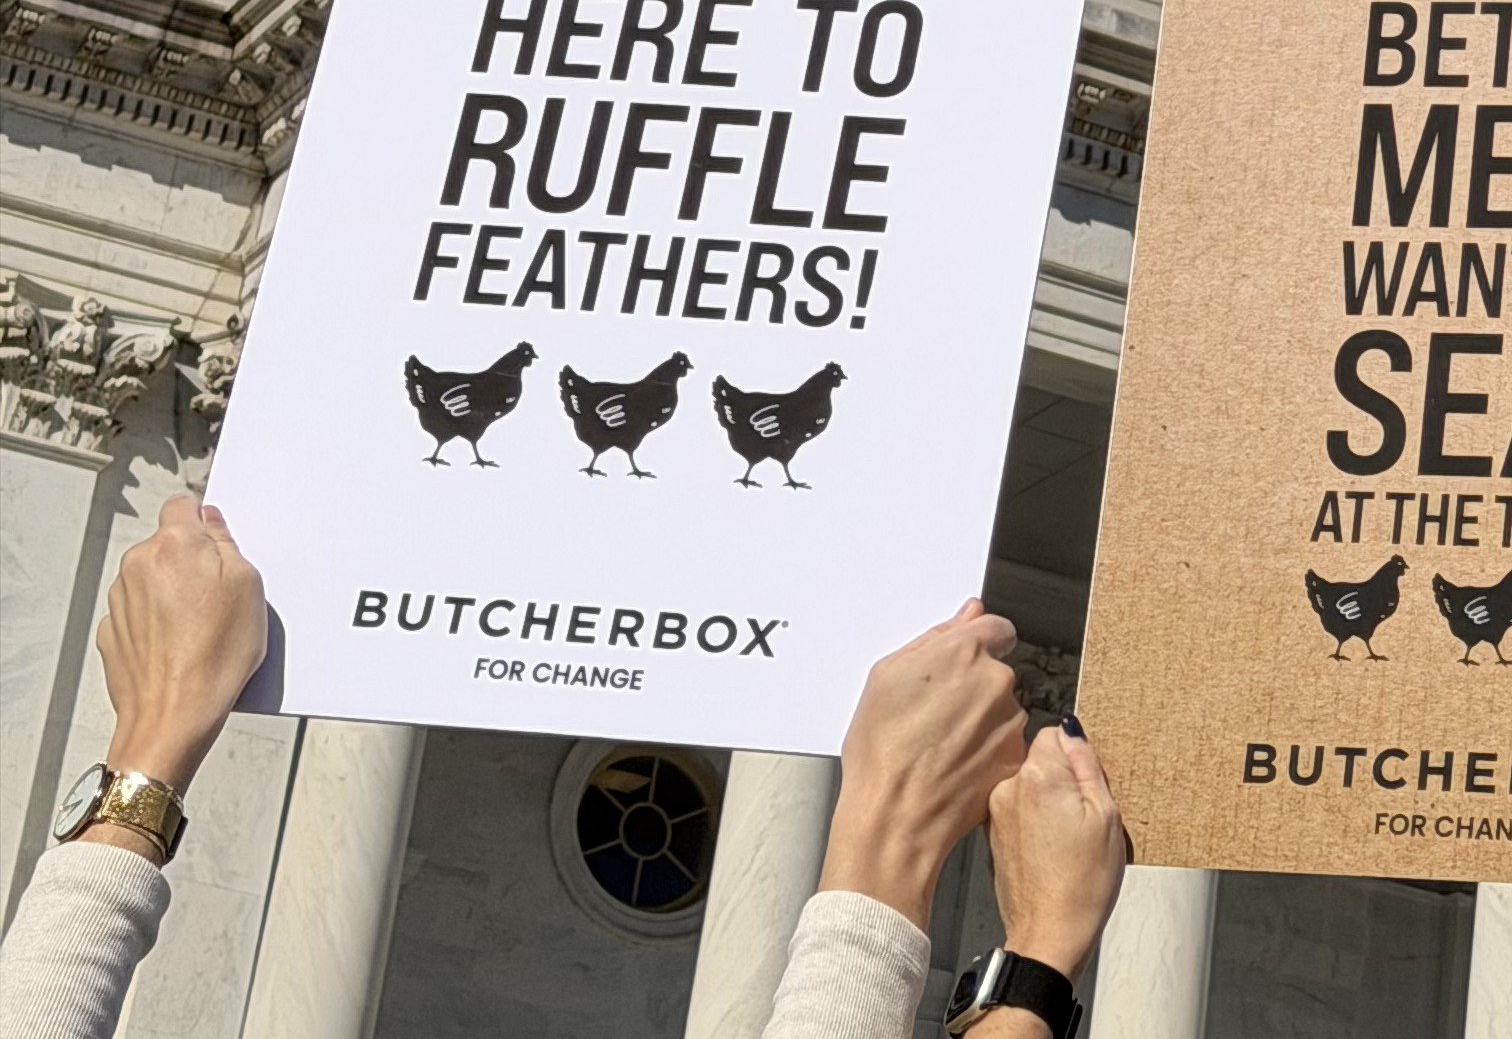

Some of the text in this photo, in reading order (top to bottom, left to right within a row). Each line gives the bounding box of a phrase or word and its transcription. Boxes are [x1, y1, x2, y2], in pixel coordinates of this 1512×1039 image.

[439, 92, 907, 233] RUFFLE
[413, 221, 880, 330] FEATHERS!
[1310, 490, 1376, 544] AT
[1385, 491, 1484, 547] THE
[352, 590, 780, 658] BUTCHERBOX
[473, 657, 645, 691] FOR CHANGE
[1374, 812, 1427, 838] FOR
